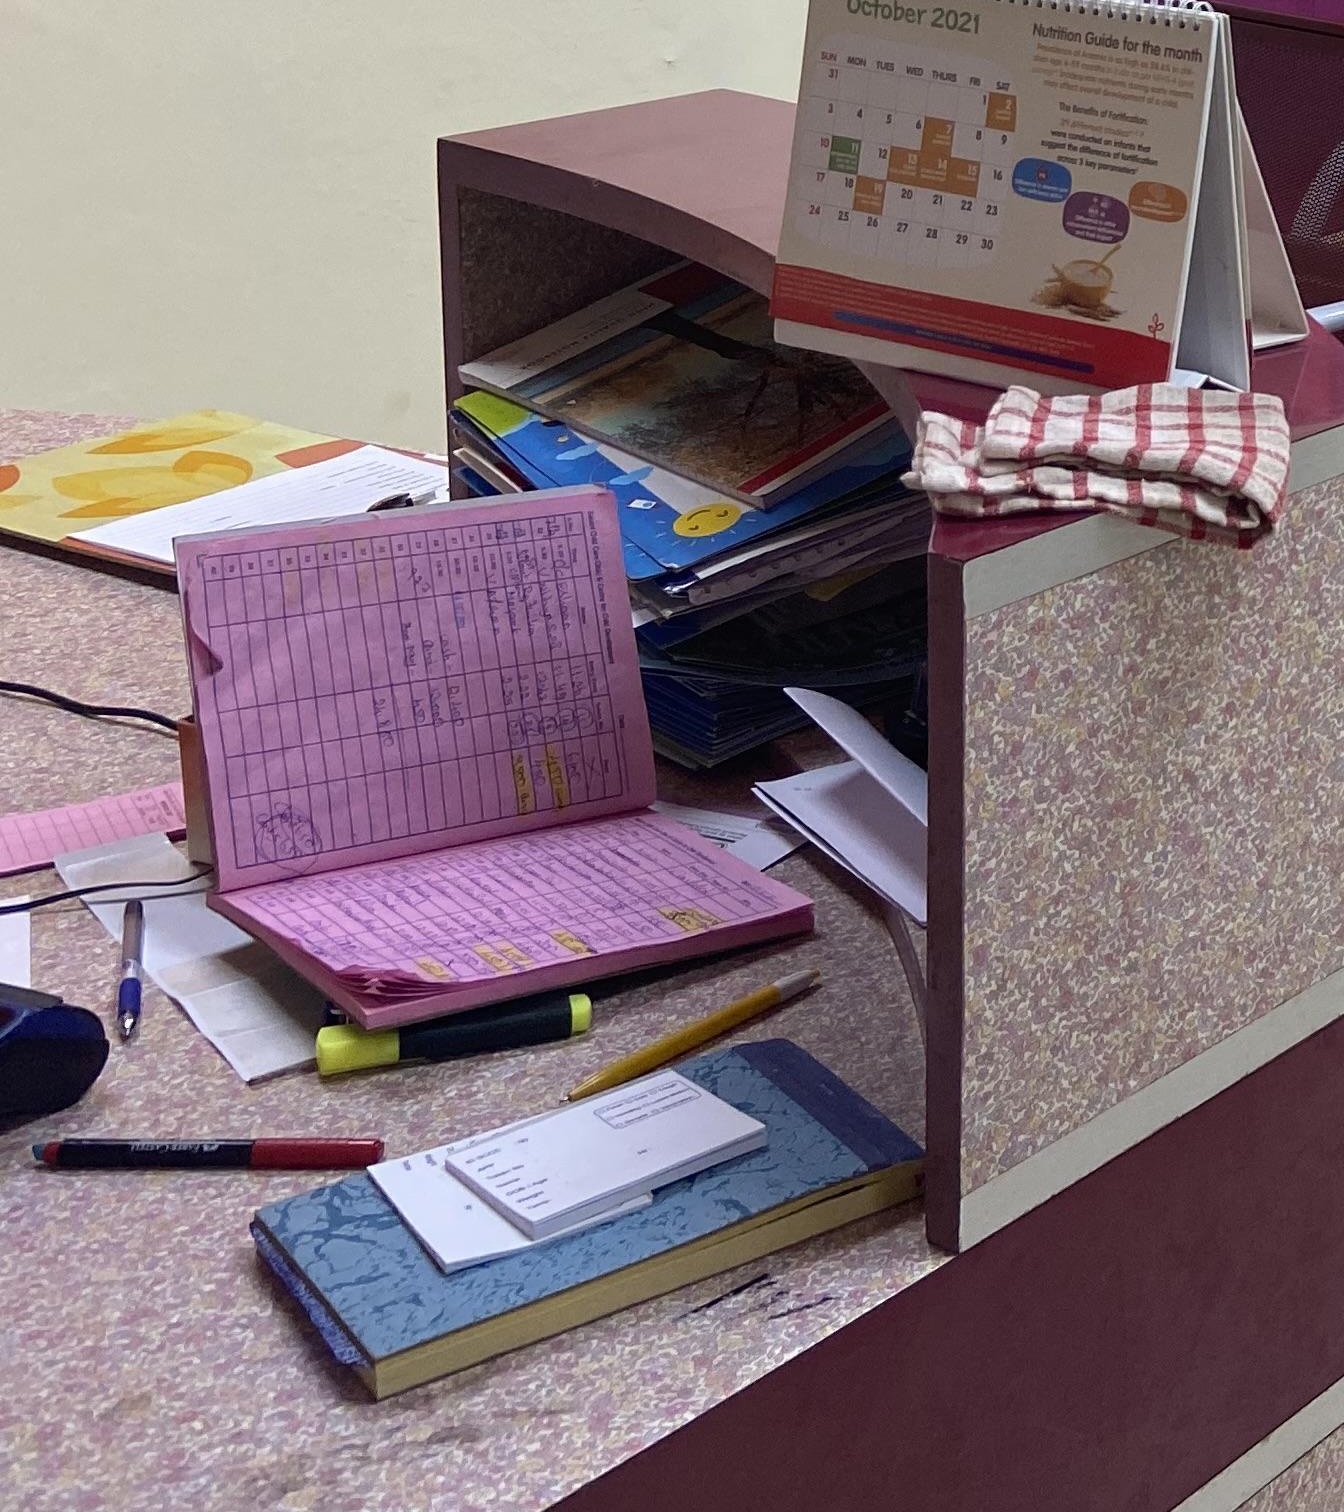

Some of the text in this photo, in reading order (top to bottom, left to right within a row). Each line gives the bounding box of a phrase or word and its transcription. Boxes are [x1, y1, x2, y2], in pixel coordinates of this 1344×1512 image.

[930, 7, 981, 34] 2021
[1032, 23, 1203, 63] Nutrition Guide for the month
[820, 51, 838, 62] SUN
[847, 56, 867, 67] MON
[876, 60, 895, 72] TUES
[905, 65, 924, 77] WED
[931, 69, 957, 82] THURS
[828, 68, 839, 80] 31
[1005, 99, 1011, 110] 2
[1058, 101, 1071, 113] The
[828, 103, 1008, 145] 3 4 5 6 7 8 9
[820, 137, 829, 148] 10
[851, 141, 859, 152] 11
[878, 148, 887, 159] 12
[967, 165, 977, 176] 15
[993, 169, 1002, 180] 16
[816, 172, 825, 182] 17
[845, 177, 854, 188] 18
[901, 188, 913, 199] 20
[932, 195, 943, 206] 21
[960, 200, 972, 211] 22
[986, 204, 998, 216] 23
[809, 204, 994, 250] 24 25 26 27 28 29 30
